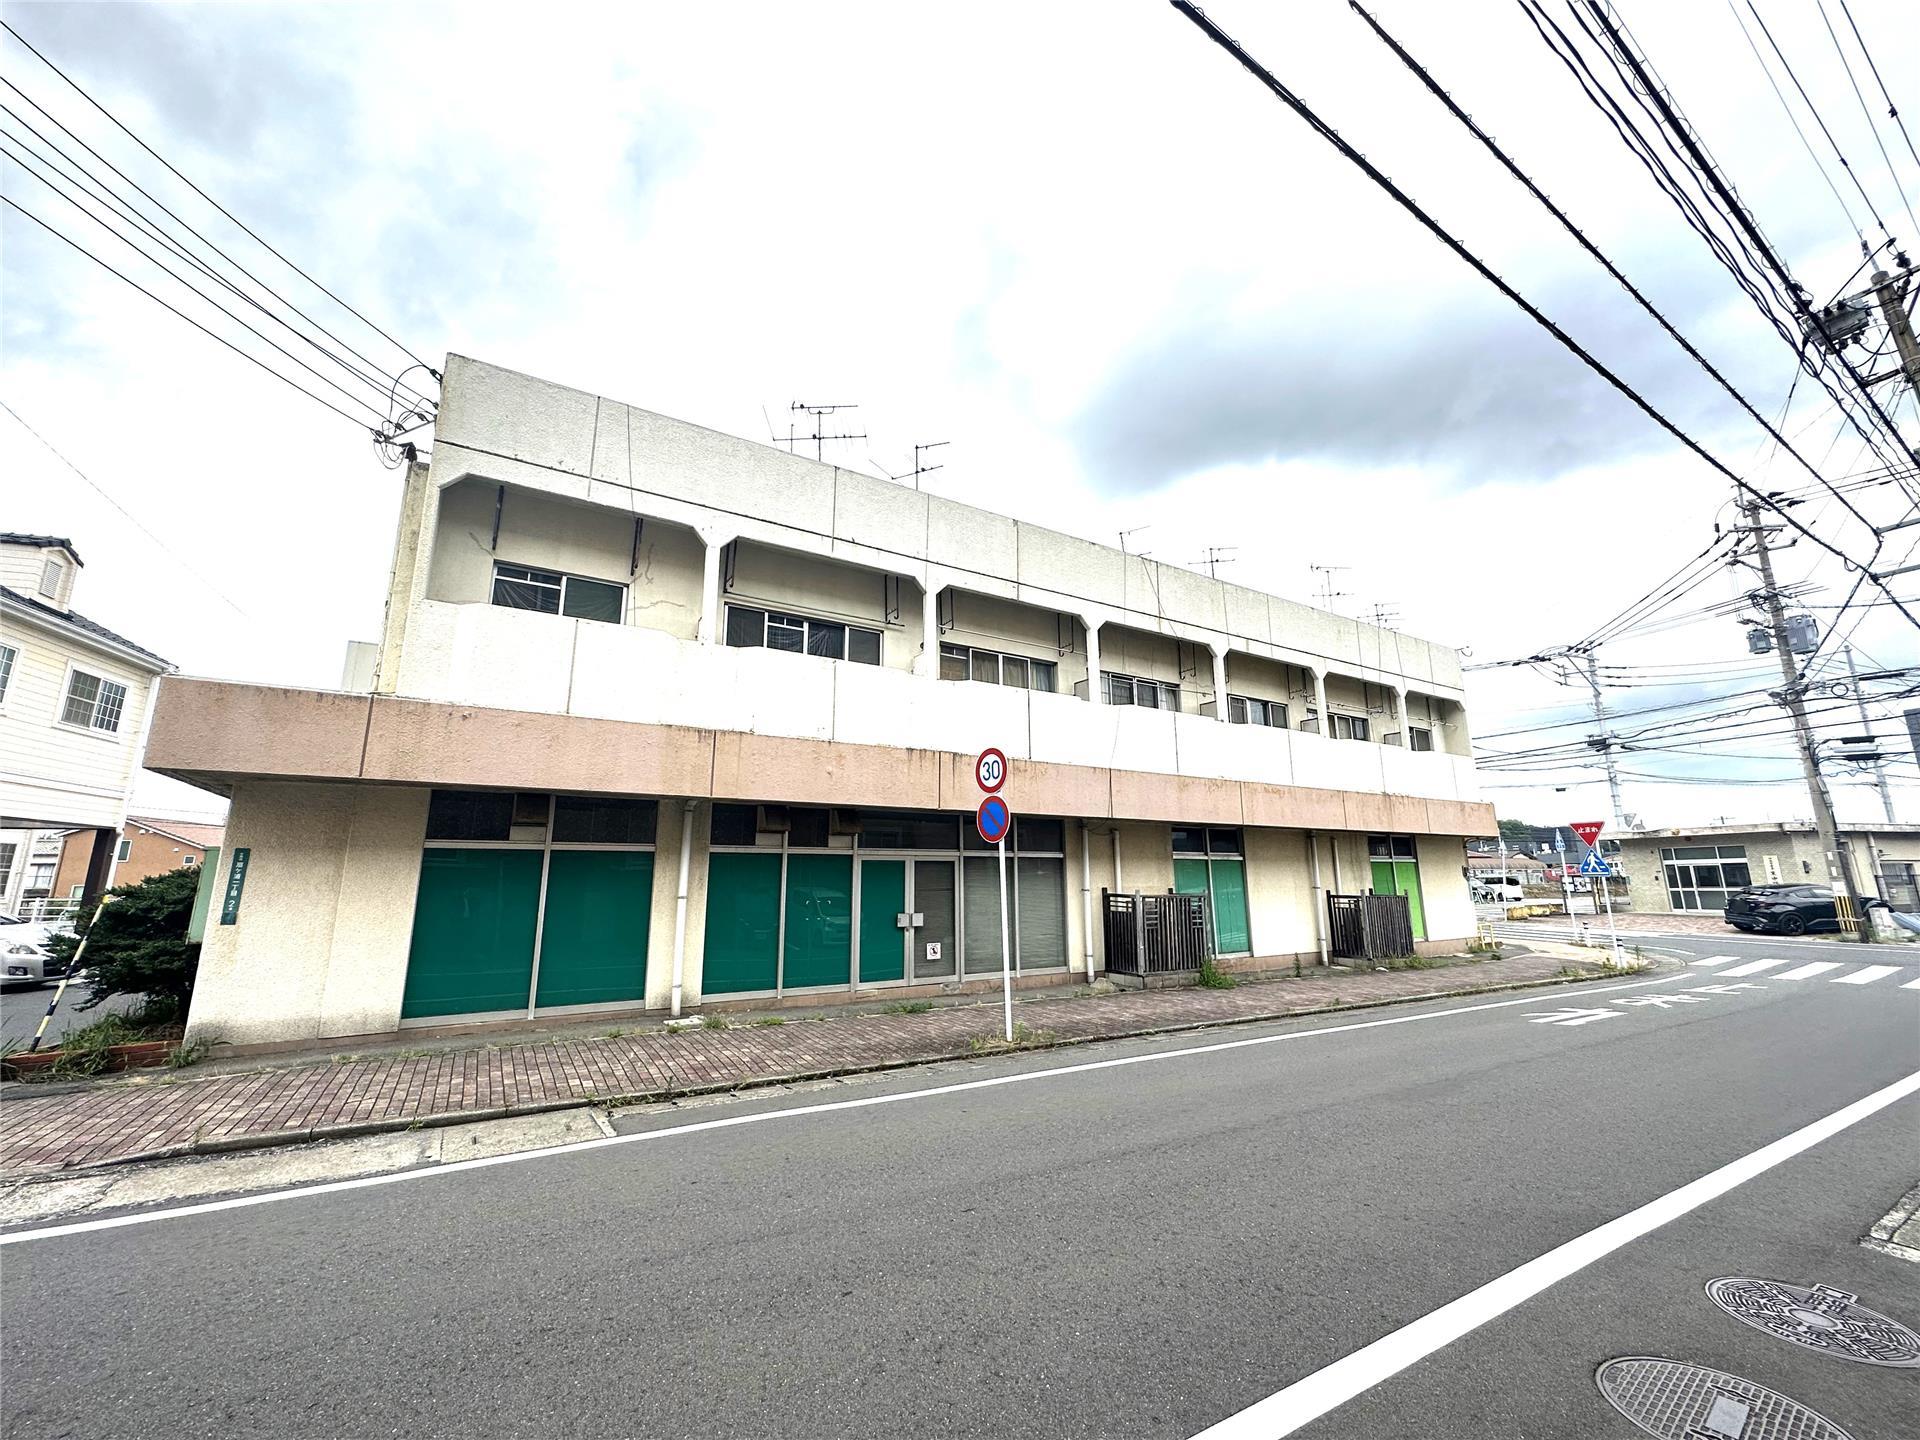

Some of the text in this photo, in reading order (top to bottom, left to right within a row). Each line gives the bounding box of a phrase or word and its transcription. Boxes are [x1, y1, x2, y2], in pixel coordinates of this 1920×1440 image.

[983, 760, 1000, 781] 30
[1520, 983, 1768, 1026] 止まれ
